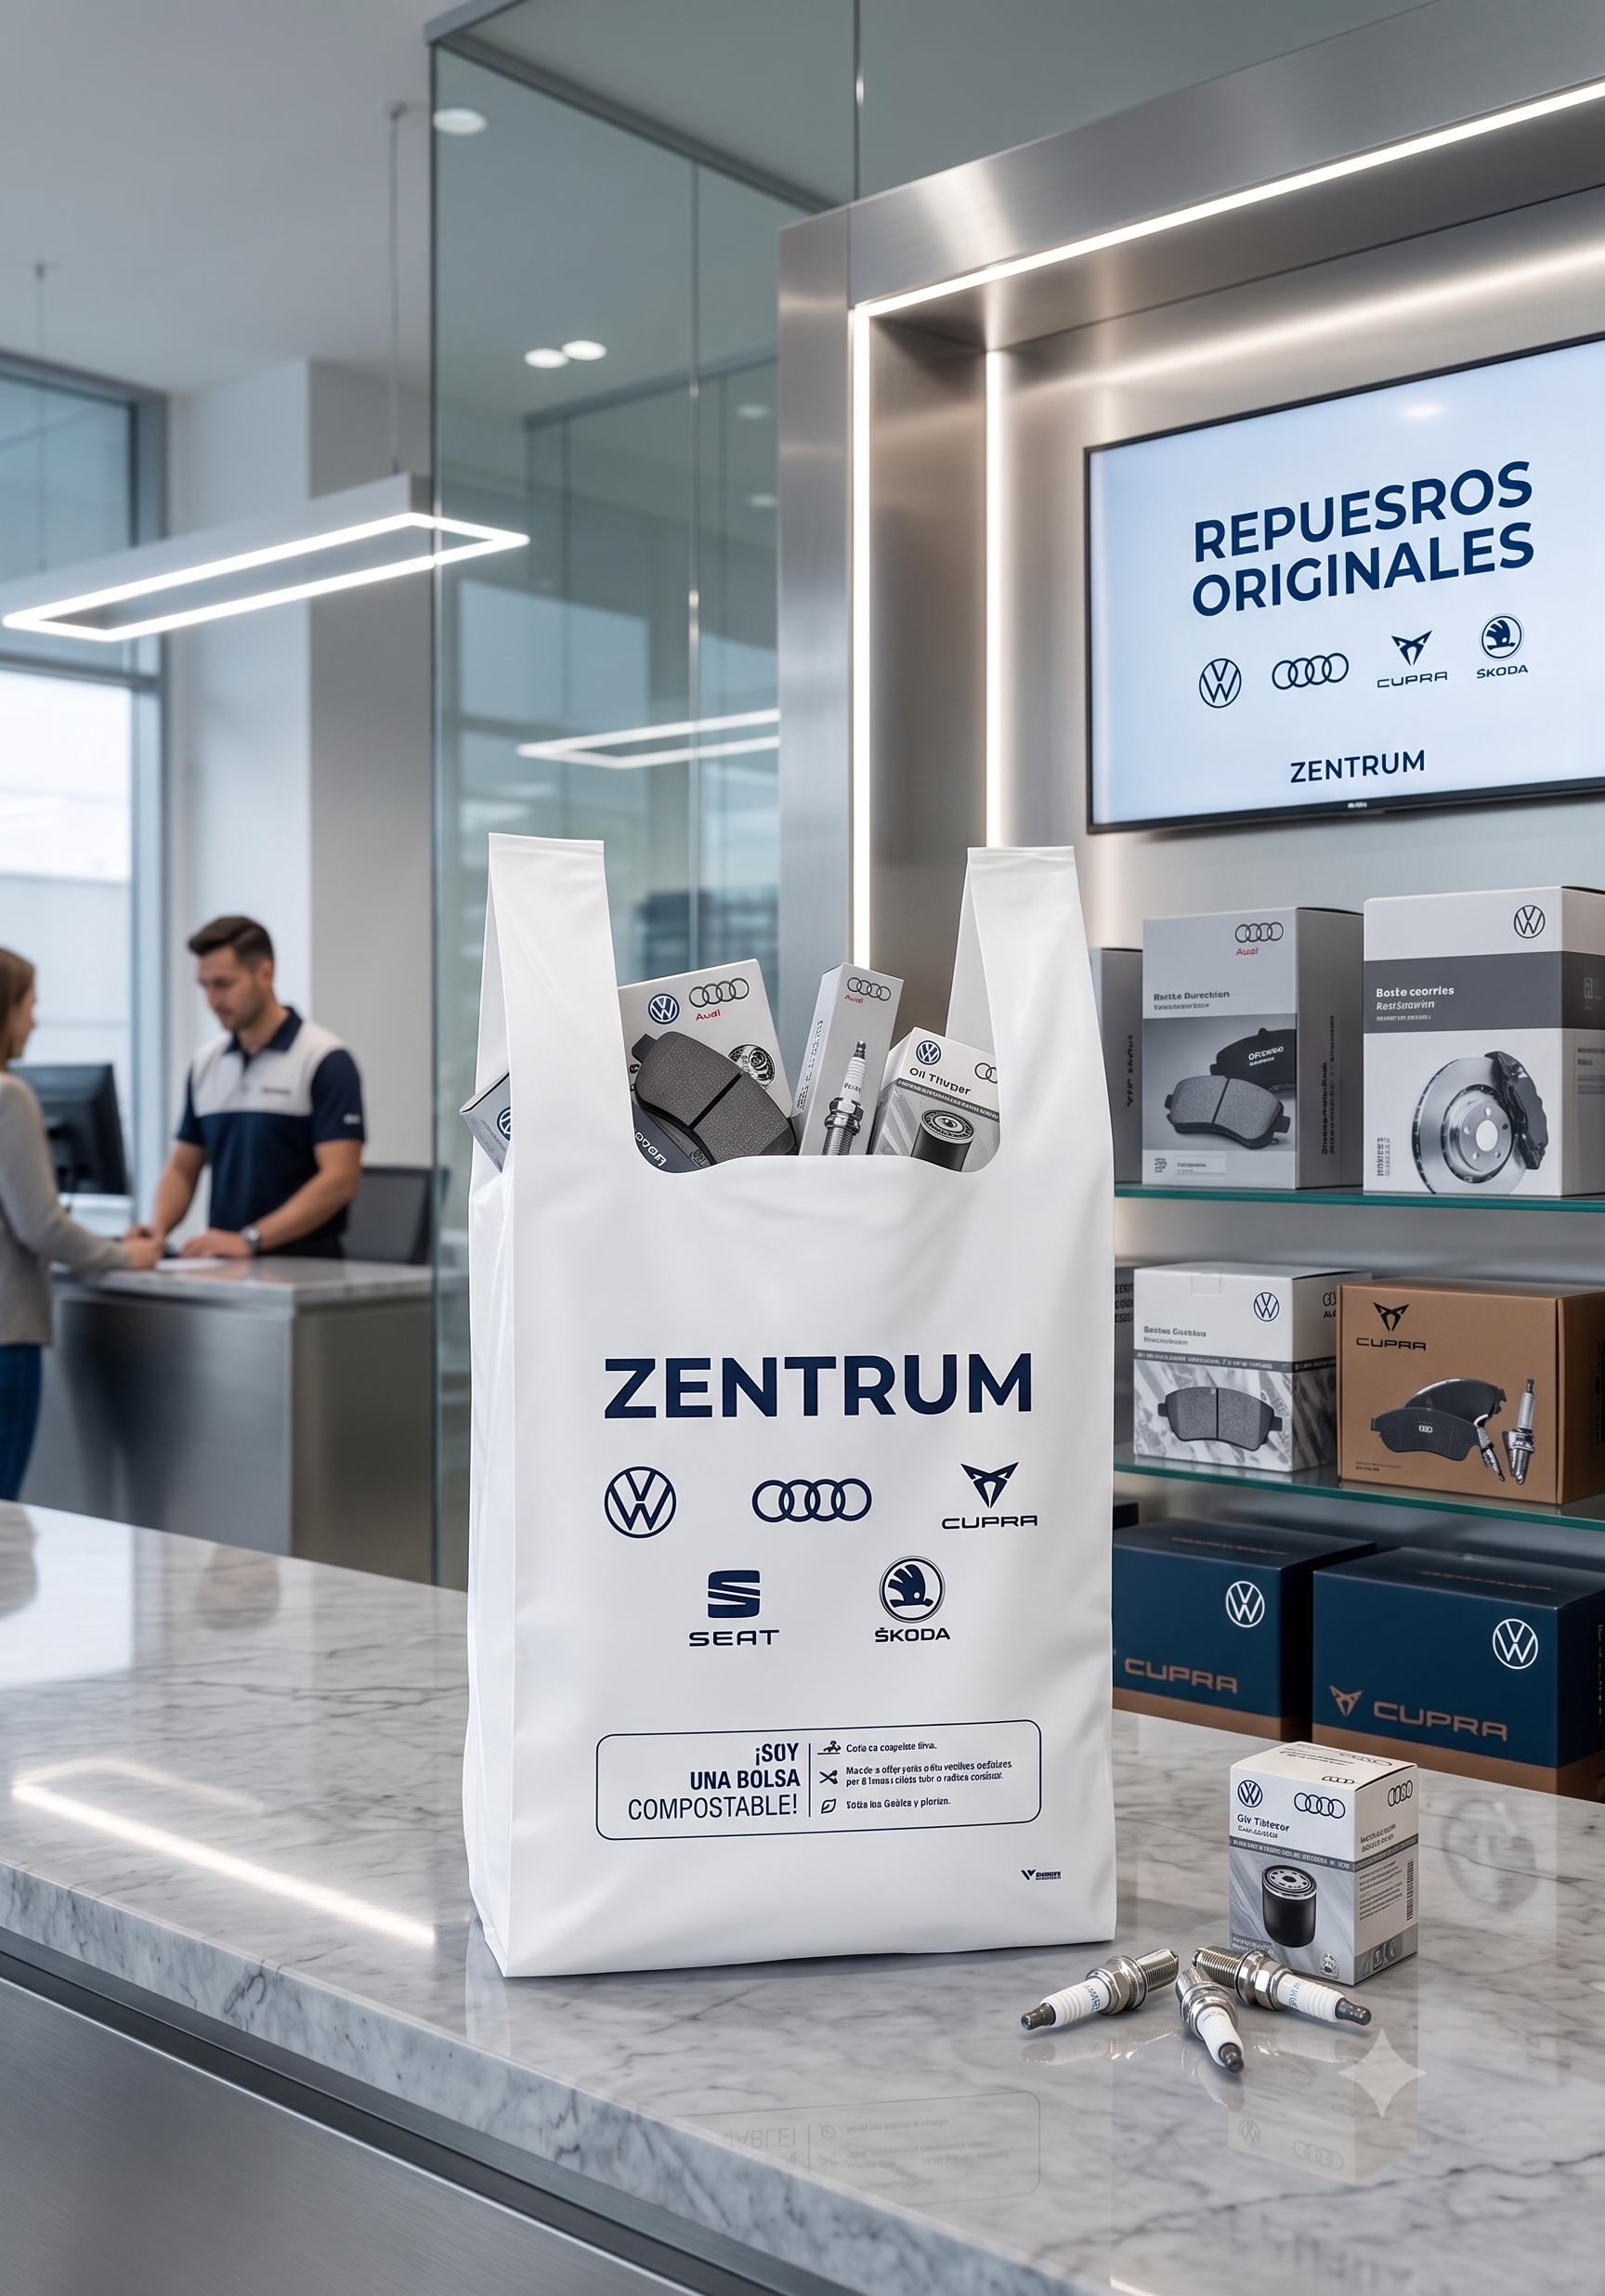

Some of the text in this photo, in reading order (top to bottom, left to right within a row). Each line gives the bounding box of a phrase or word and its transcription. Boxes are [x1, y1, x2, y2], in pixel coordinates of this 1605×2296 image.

[1194, 460, 1533, 563] REPUESROS
[1193, 521, 1534, 617] ORIGINALES
[1377, 671, 1448, 688] CUPRA
[1290, 750, 1425, 783] ZENTRUM
[1356, 1337, 1427, 1352] CUPRA
[604, 1352, 1032, 1419] ZENTRUM
[942, 1515, 1037, 1530] CUPRA
[688, 1630, 779, 1647] SEAT
[874, 1627, 951, 1643] ŠKODA
[1124, 1657, 1238, 1693] CUPRA
[1373, 1700, 1507, 1742] CUPRA
[755, 1742, 800, 1765] ¡SOY
[690, 1768, 801, 1791] UNA BOLSA
[846, 1779, 859, 1788] per
[628, 1794, 798, 1820] COMPOSTABLE!
